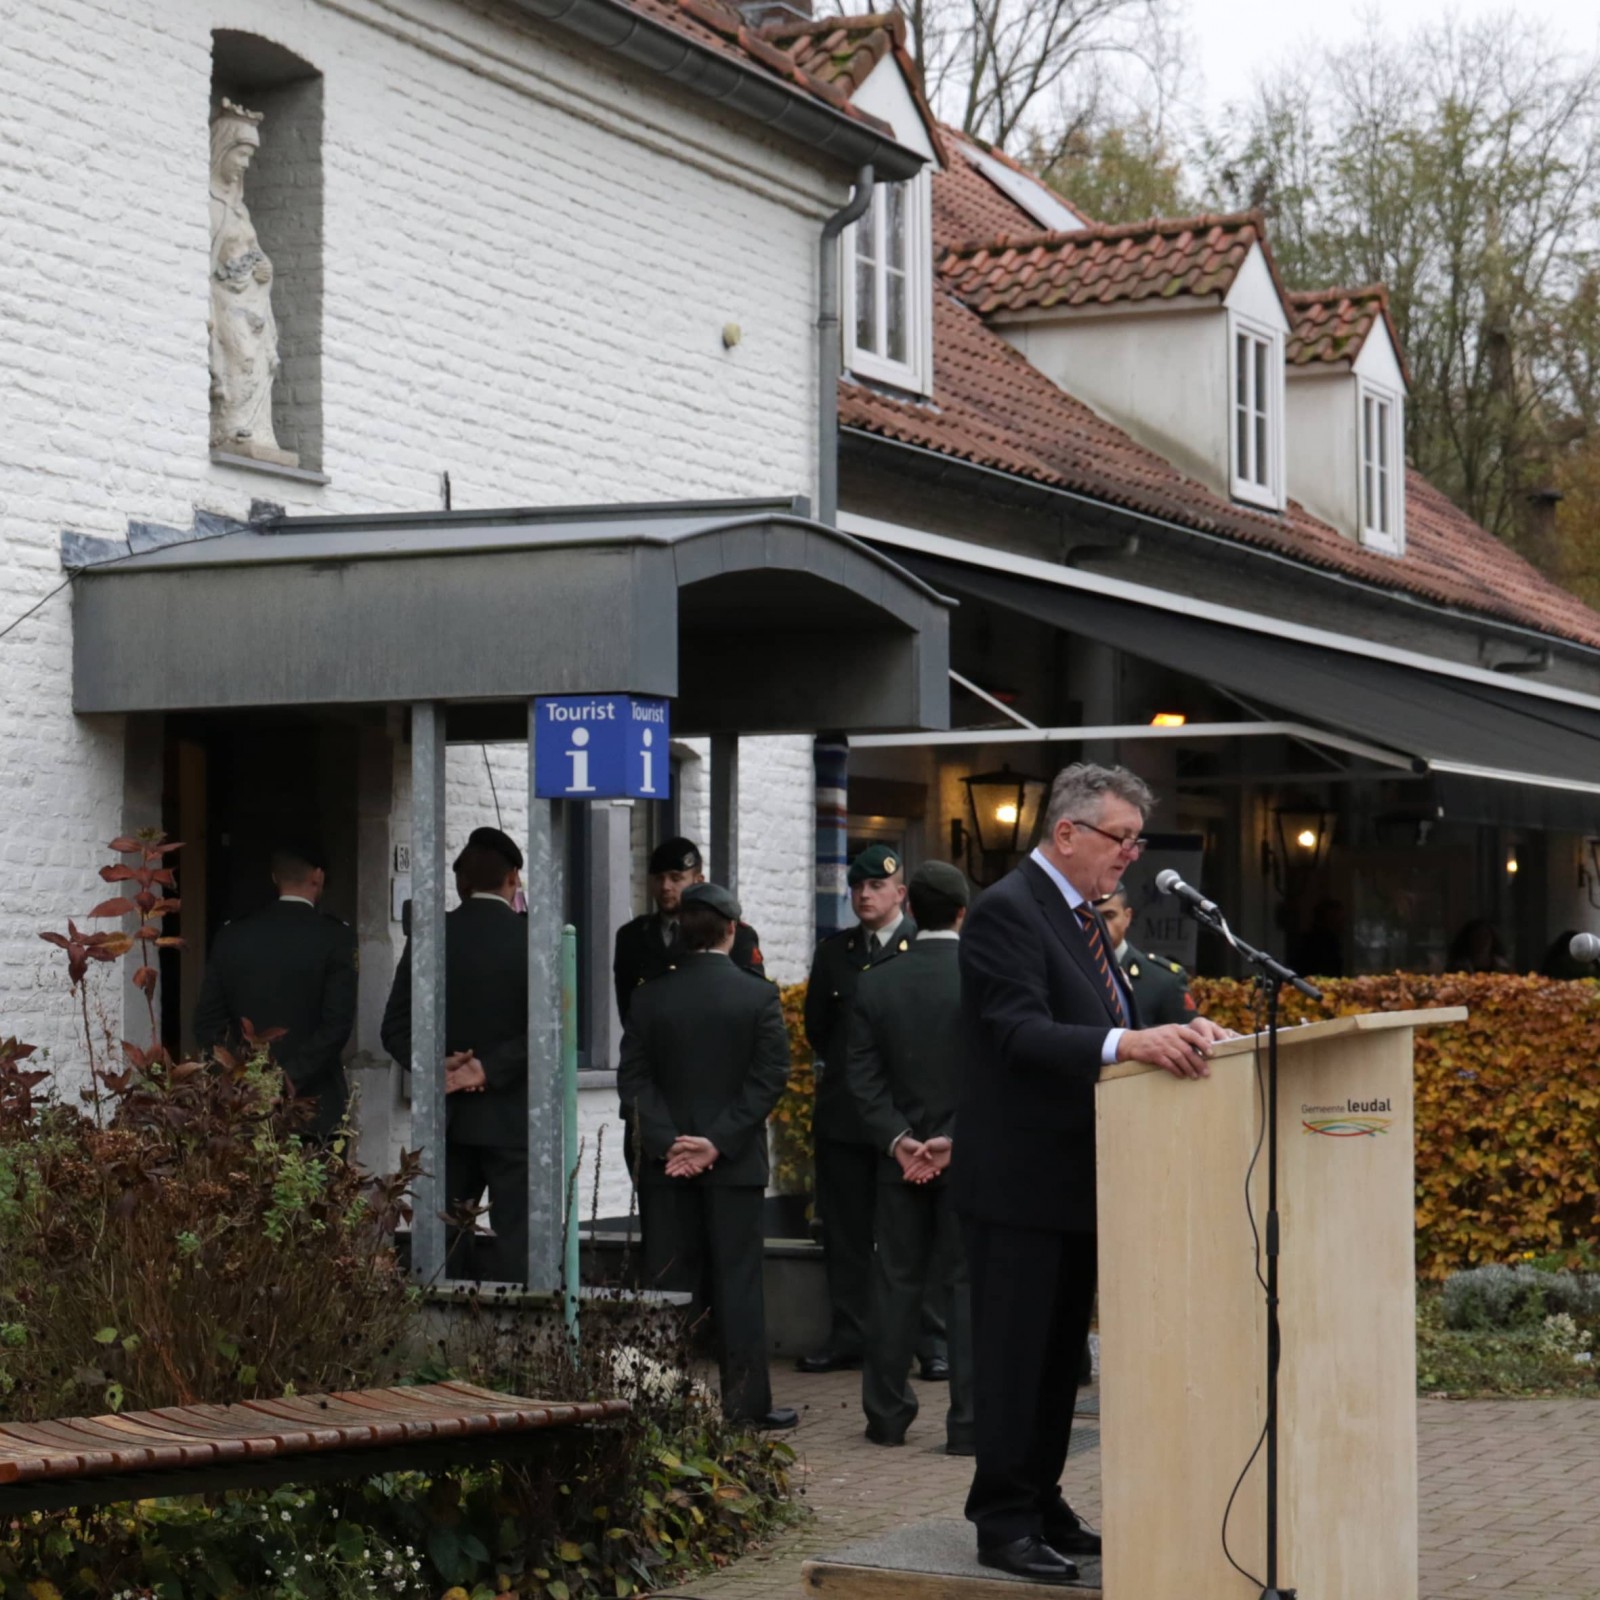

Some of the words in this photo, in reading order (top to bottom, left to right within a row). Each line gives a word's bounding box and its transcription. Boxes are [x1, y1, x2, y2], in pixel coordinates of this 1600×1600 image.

[546, 701, 615, 721] Tourist
[631, 702, 664, 723] Tourist
[1301, 1104, 1345, 1114] Gemeente
[1347, 1098, 1391, 1113] leudal
